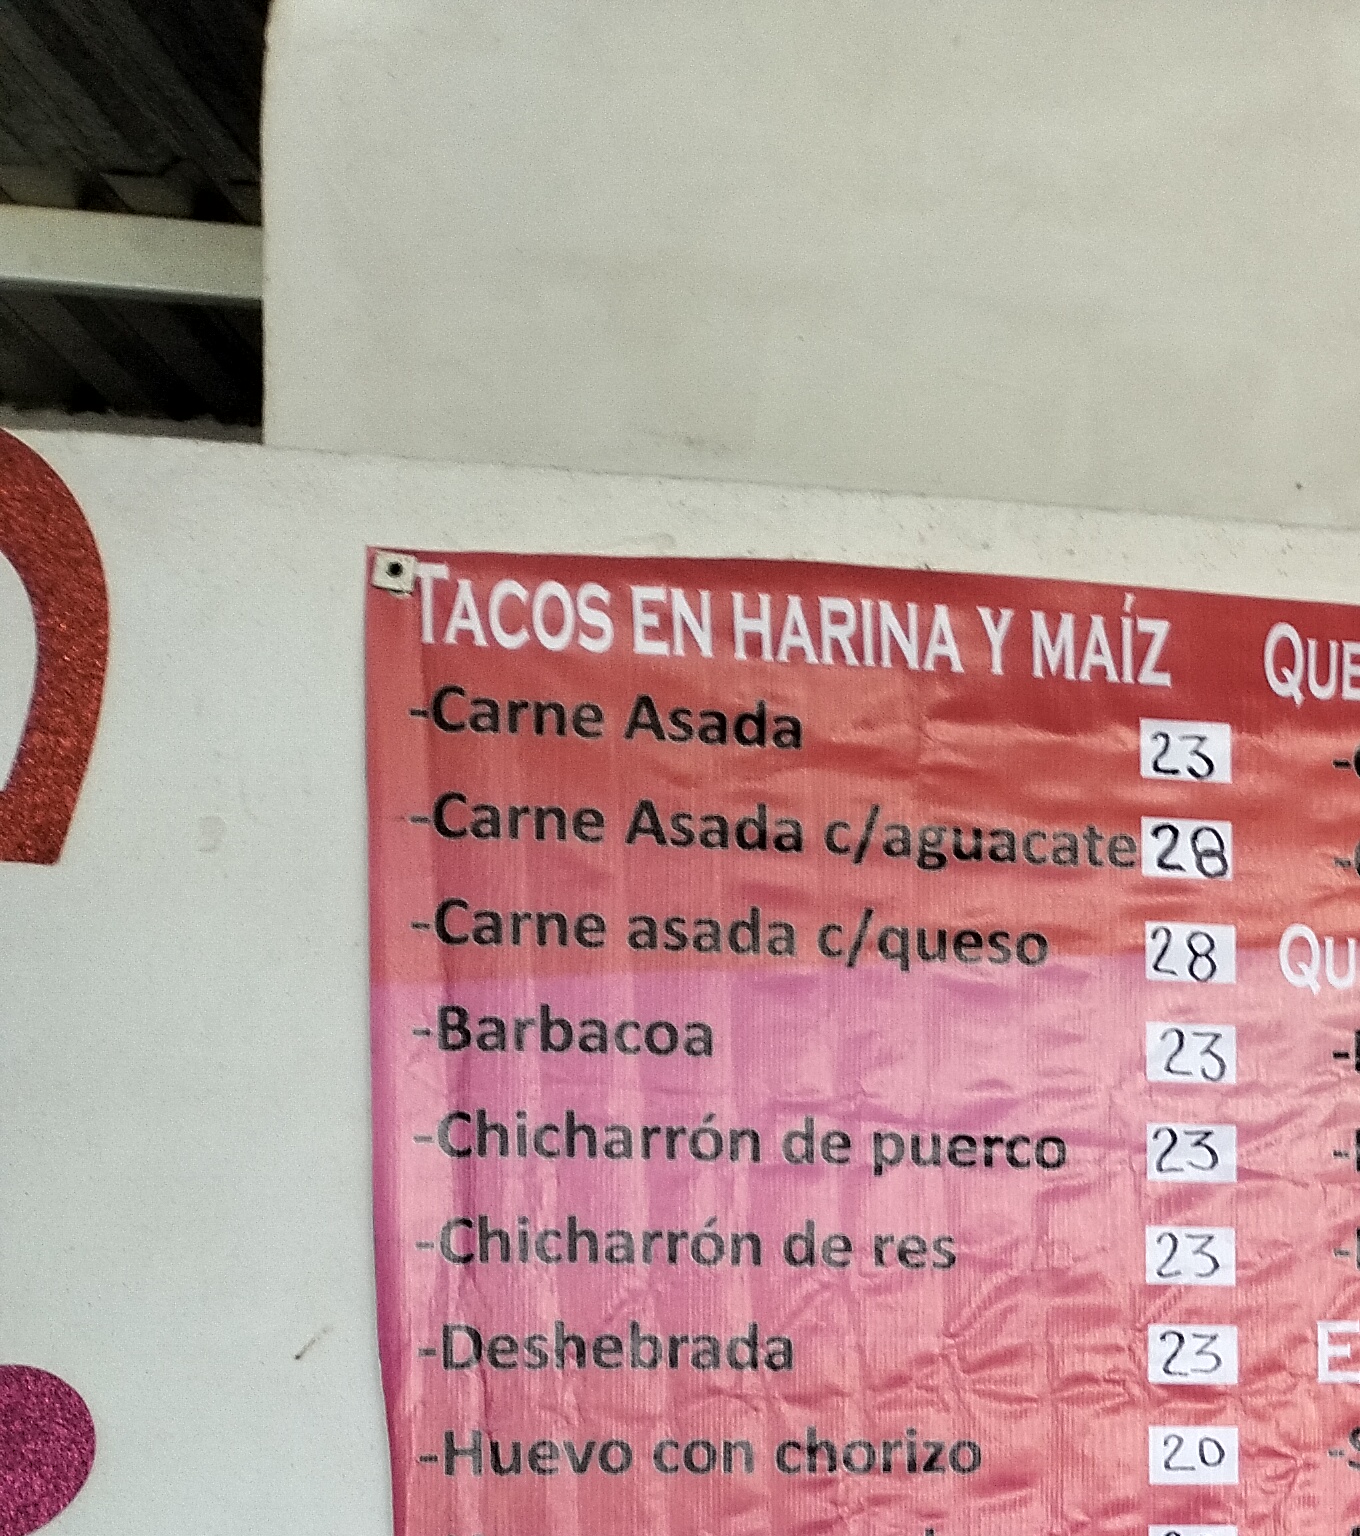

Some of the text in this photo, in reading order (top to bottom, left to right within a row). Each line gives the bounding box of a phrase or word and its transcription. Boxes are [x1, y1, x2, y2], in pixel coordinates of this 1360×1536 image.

[415, 564, 1172, 686] TACOS EN HARINA Y MAÍZ
[624, 695, 803, 749] Asada
[1151, 733, 1215, 778] 23
[626, 801, 803, 854] Asada
[825, 806, 1137, 872] c/aguacate
[1152, 825, 1230, 878] 28
[1160, 1029, 1226, 1082] 23
[783, 1118, 851, 1166] de
[873, 1128, 1067, 1175] puerco
[1152, 1128, 1219, 1173] 23
[1160, 1329, 1222, 1376] 23
[653, 1440, 754, 1475] con
[776, 1428, 983, 1475] chorizo
[1163, 1435, 1225, 1471] 20
